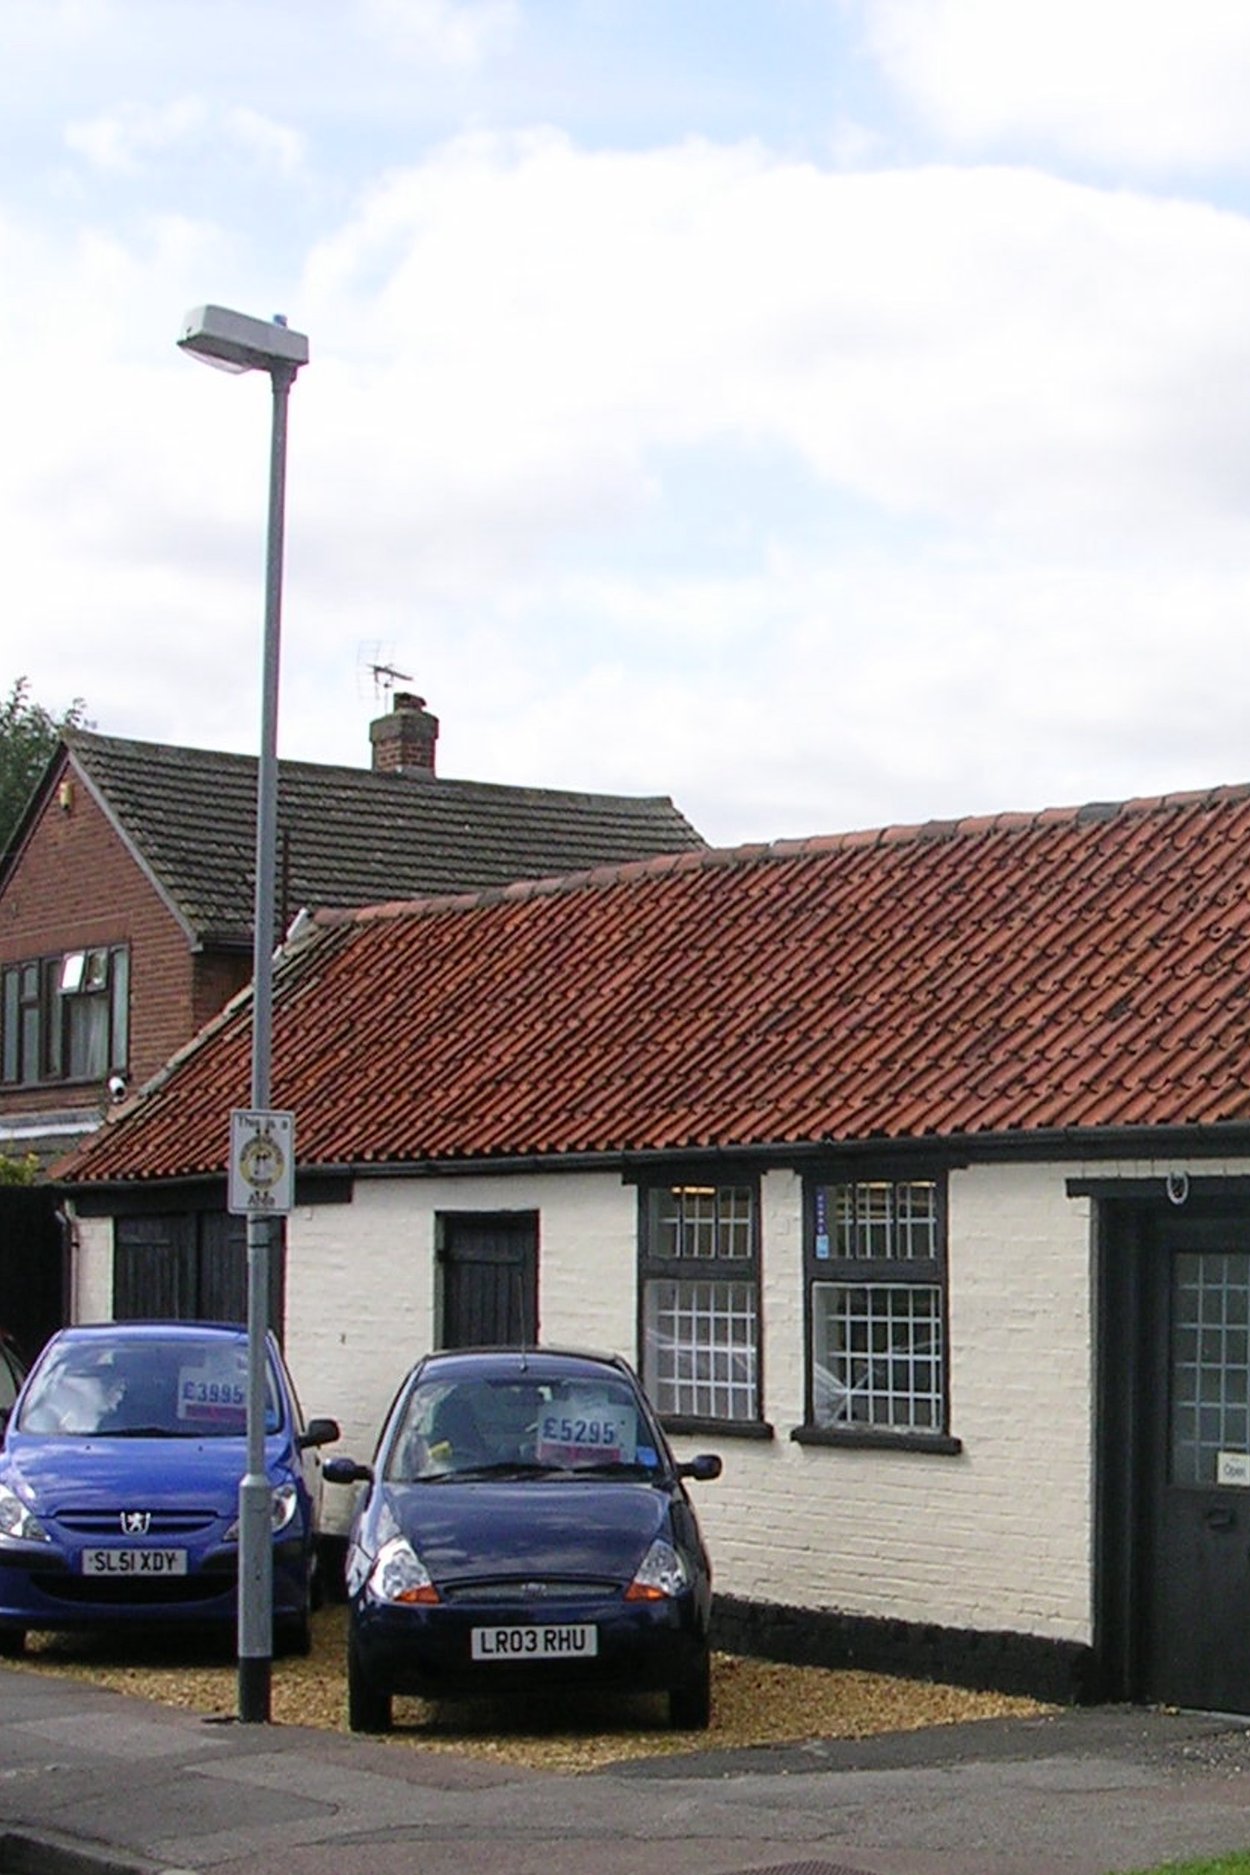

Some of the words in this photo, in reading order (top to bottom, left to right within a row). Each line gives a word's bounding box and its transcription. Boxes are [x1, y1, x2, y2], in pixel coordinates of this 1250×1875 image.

[183, 1382, 244, 1404] £3995
[542, 1417, 615, 1444] £5295
[141, 1551, 176, 1571] XDY
[481, 1630, 538, 1653] LR03
[543, 1629, 586, 1652] RHU
